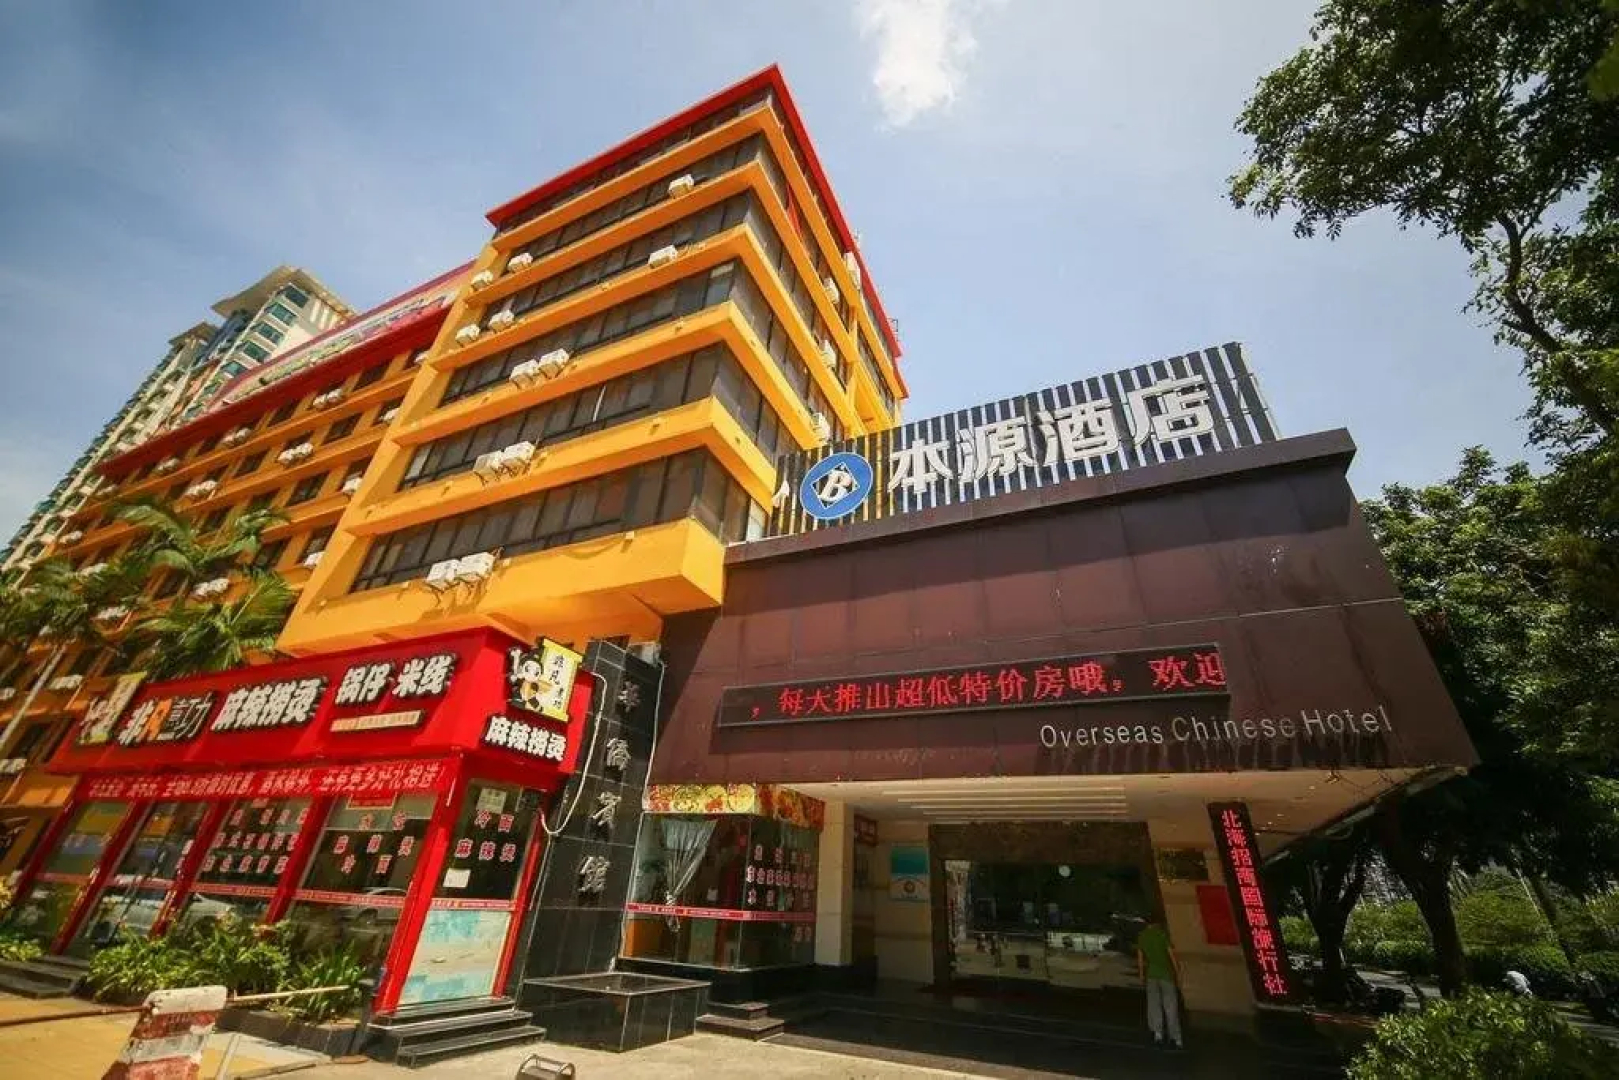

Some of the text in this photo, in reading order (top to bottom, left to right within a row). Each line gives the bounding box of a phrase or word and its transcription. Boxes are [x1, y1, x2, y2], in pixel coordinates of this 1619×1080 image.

[888, 374, 1215, 494] 本源酒店
[1040, 705, 1392, 748] Overseas Chinese Hotel
